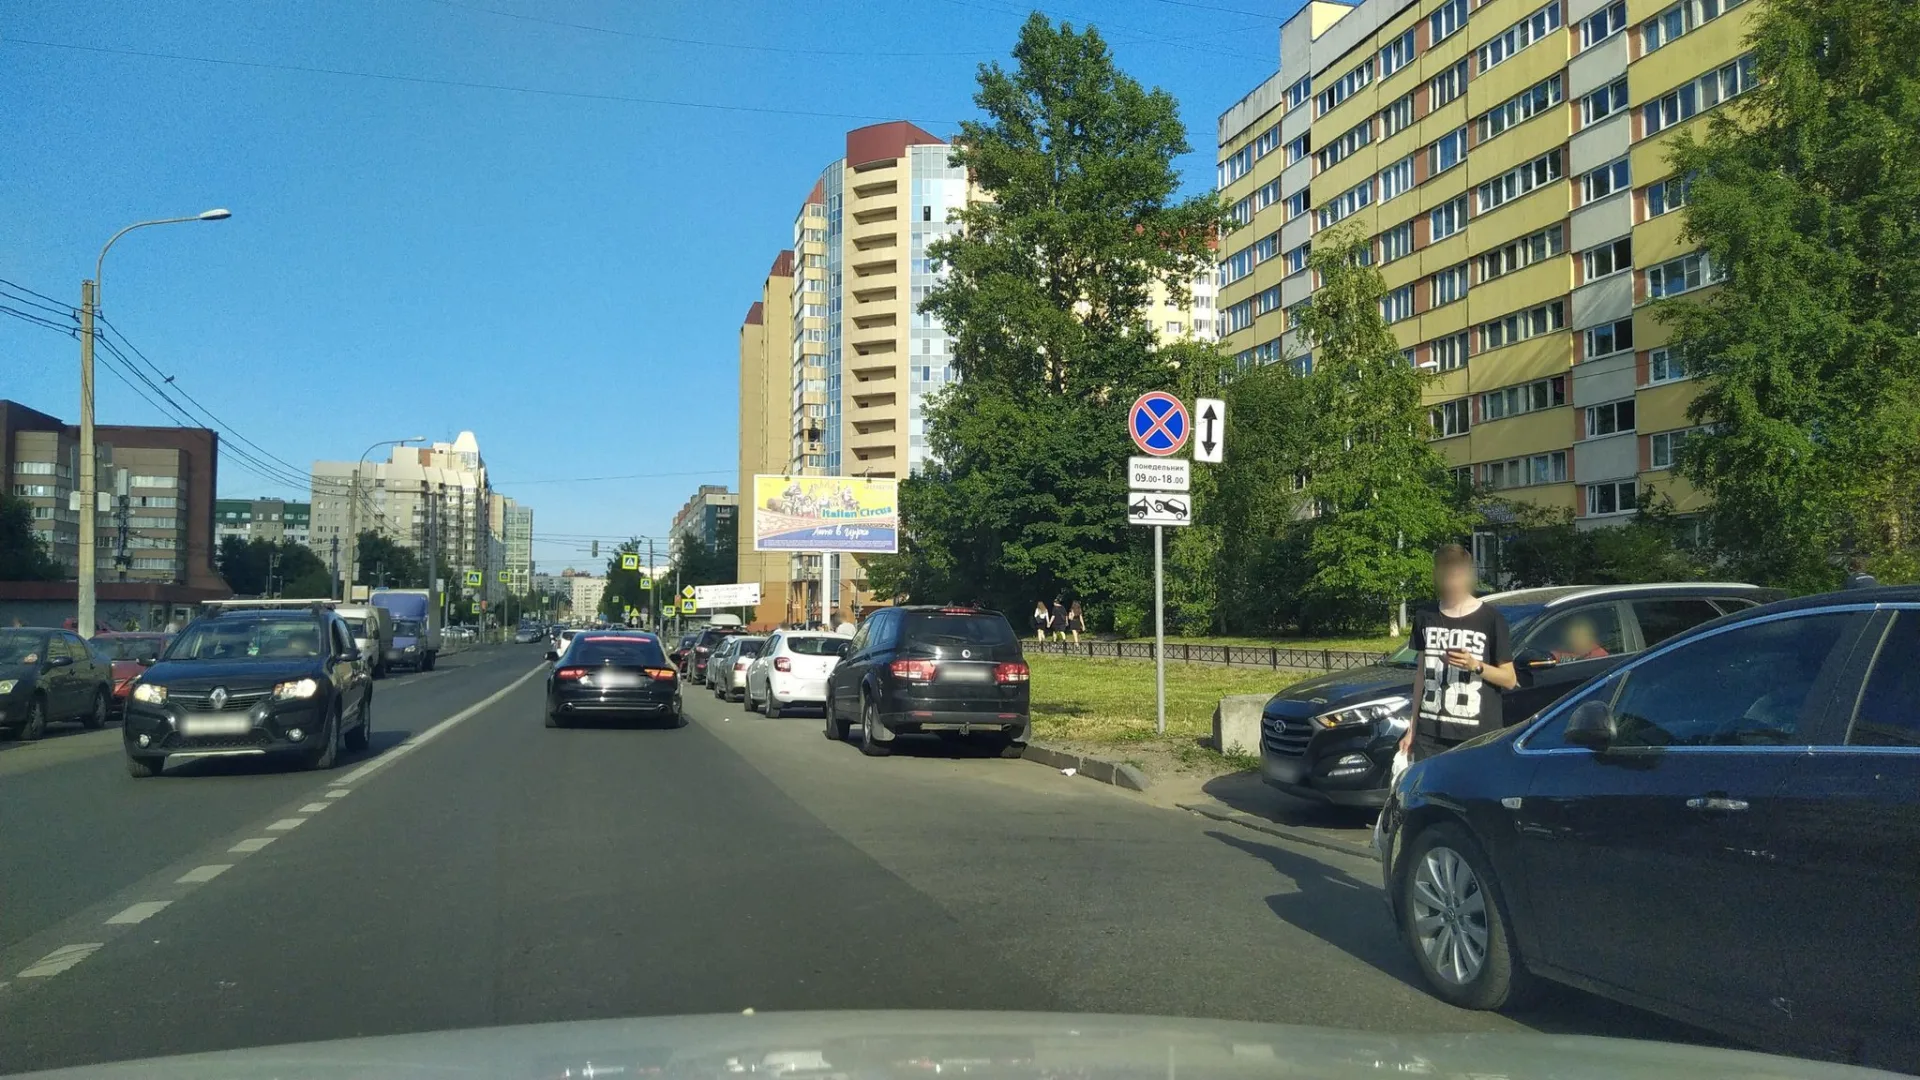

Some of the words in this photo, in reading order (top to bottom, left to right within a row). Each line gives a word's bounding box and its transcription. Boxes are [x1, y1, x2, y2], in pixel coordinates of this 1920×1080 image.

[1134, 463, 1184, 471] понедельник
[1135, 473, 1184, 484] 09.00-18.00
[822, 508, 857, 518] Italian
[859, 506, 892, 517] Circus
